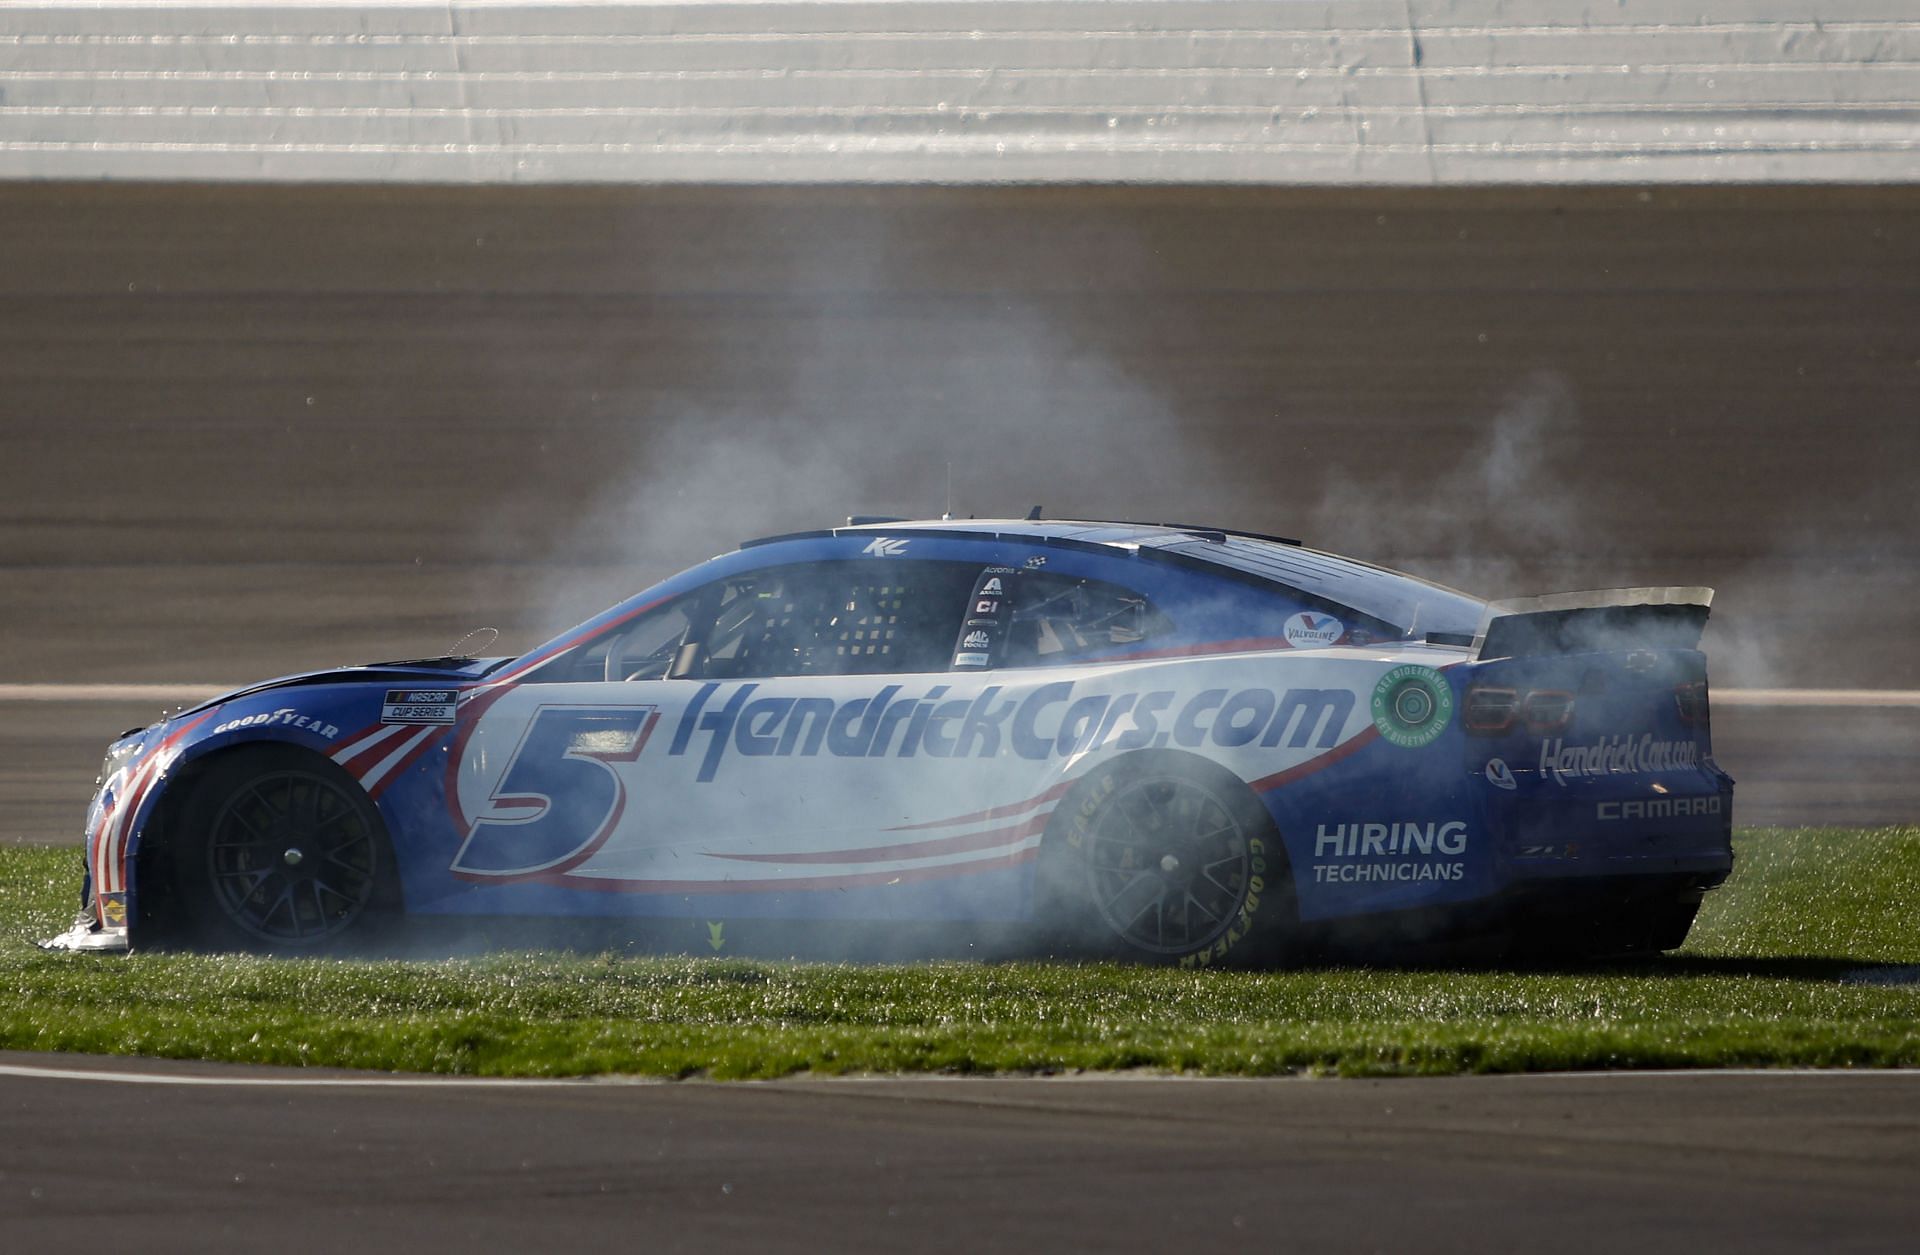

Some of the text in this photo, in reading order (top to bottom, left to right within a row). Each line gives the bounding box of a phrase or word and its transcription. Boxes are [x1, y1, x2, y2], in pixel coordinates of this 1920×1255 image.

[1378, 666, 1447, 693] GET BIOETHANOL
[408, 692, 448, 702] NASCAR
[213, 709, 340, 739] GOODYEAR
[392, 707, 446, 717] CUP SERIES
[668, 681, 1355, 782] HendrickCars.com
[1376, 716, 1447, 745] GET BIOETHANOL
[450, 704, 661, 883] 5
[1597, 796, 1721, 820] CAMARO
[1067, 774, 1115, 849] EAGLE
[1315, 821, 1467, 856] HIRING
[1313, 862, 1464, 882] TECHNICIANS
[1180, 837, 1266, 968] GOODYEAR
